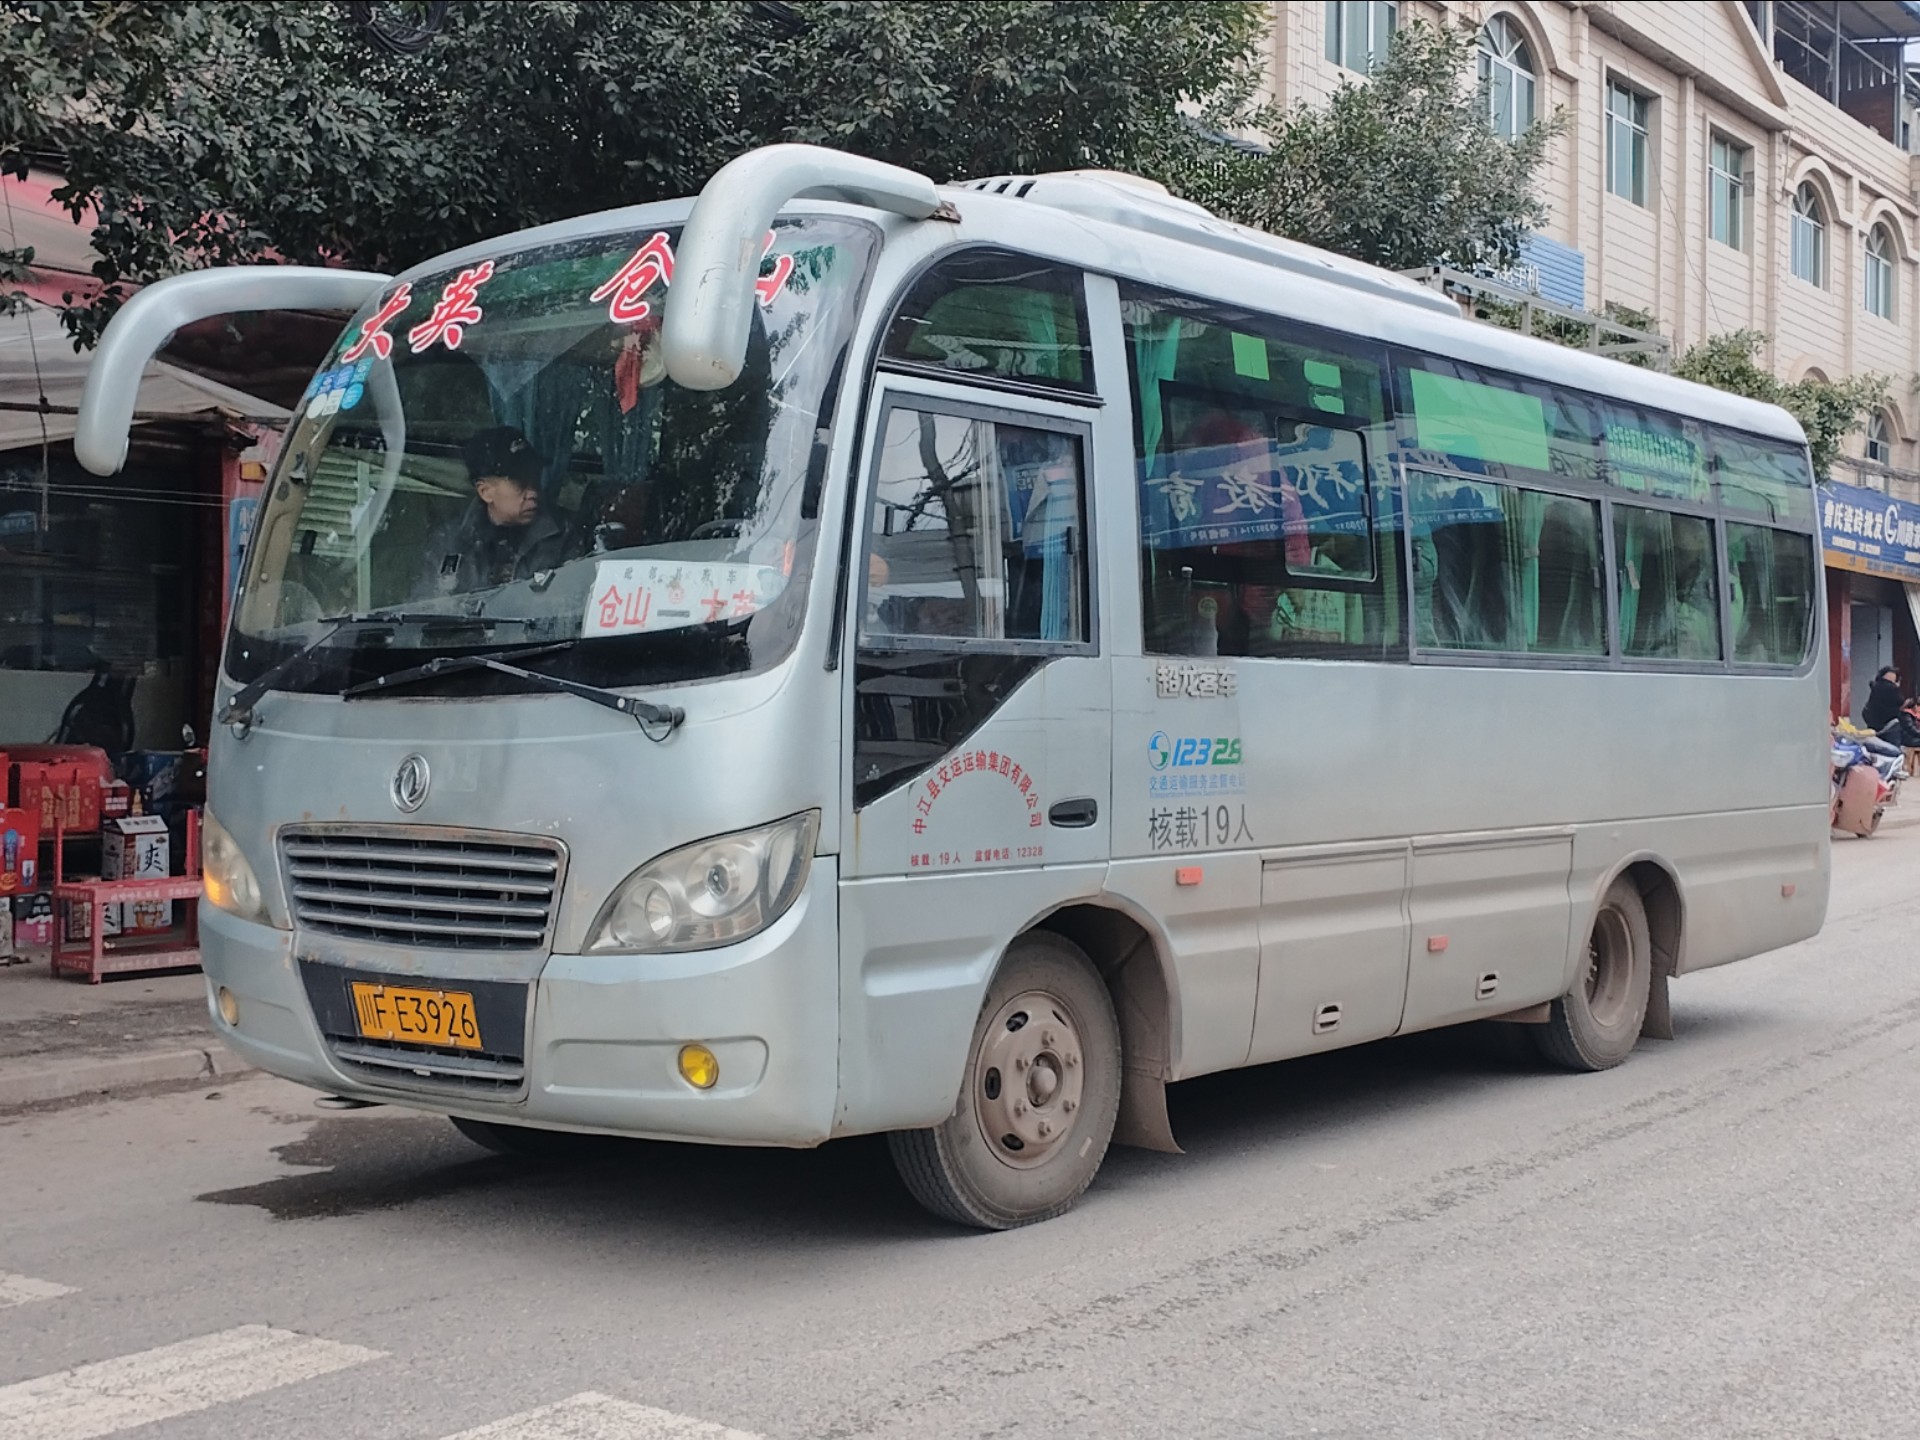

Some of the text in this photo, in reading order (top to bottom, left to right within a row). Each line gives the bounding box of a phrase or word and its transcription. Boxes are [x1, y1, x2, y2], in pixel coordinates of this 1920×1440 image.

[1156, 664, 1239, 699] 超龙客车
[911, 749, 1043, 835] 中江县交运运输集团有限公司
[1148, 803, 1254, 851] 核载19人
